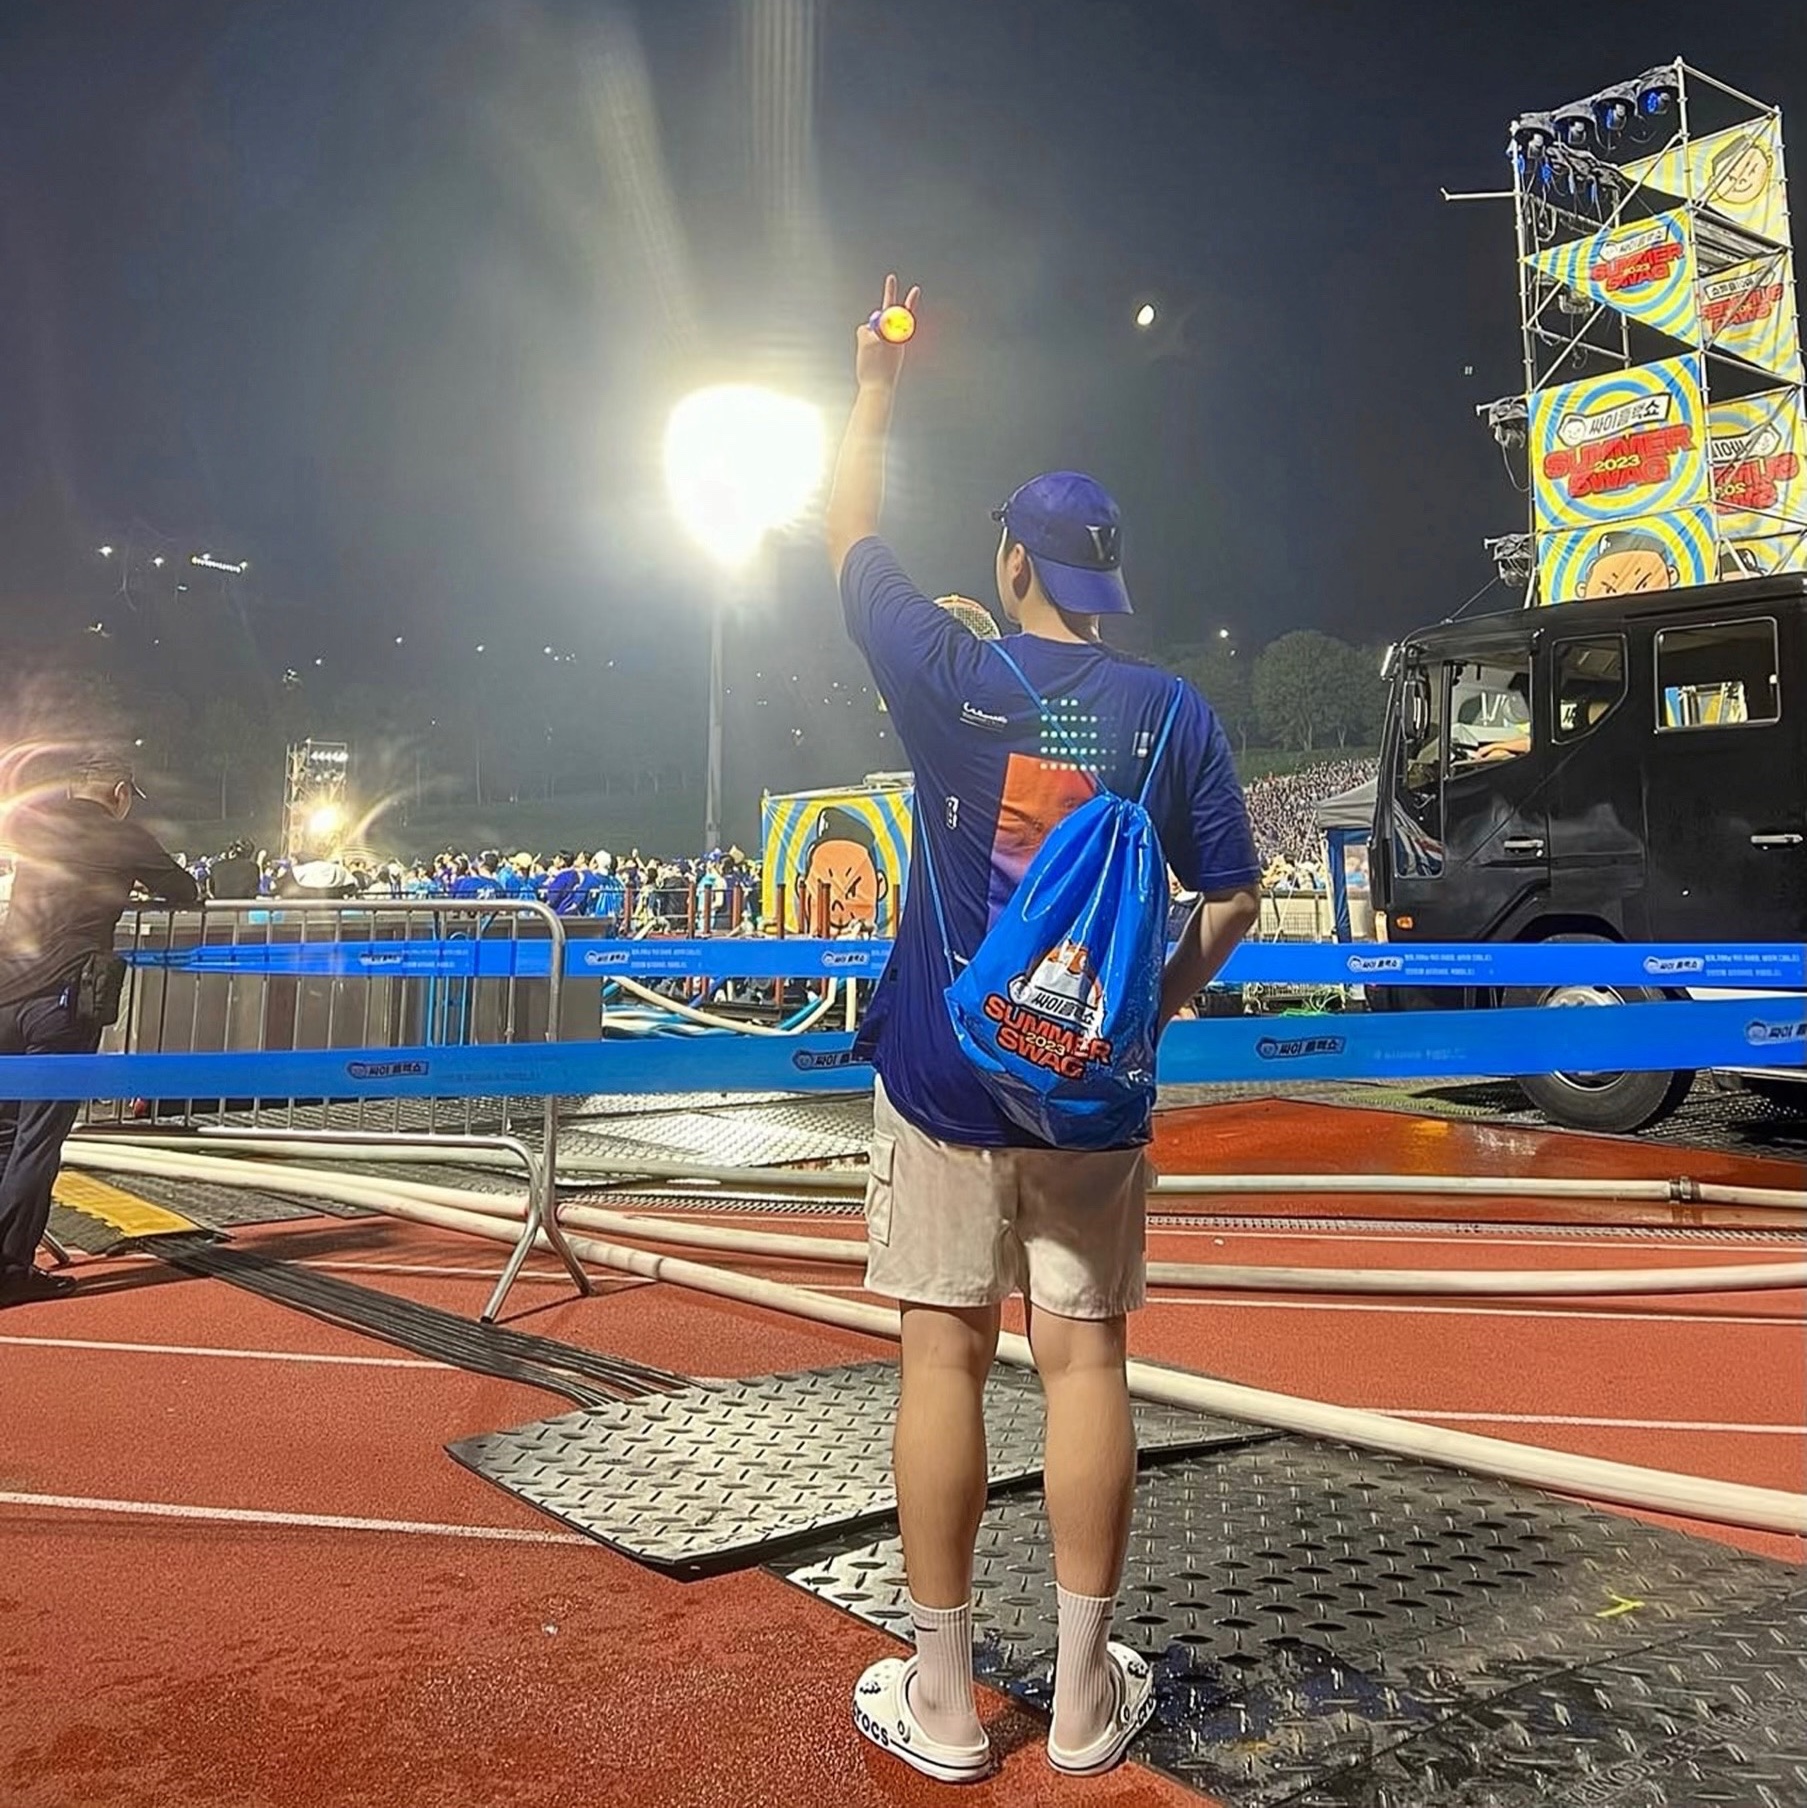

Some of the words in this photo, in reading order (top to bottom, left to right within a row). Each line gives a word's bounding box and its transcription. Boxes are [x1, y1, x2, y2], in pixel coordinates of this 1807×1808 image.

[1591, 243, 1684, 280] SUMMER
[1607, 263, 1669, 290] SWAG
[1545, 425, 1694, 479] SUMMER
[1594, 455, 1641, 473] 2023
[1569, 458, 1670, 497] SWAG
[984, 995, 1111, 1063] SUMMER
[1026, 1032, 1066, 1056] 2023
[998, 1026, 1083, 1077] SWAG
